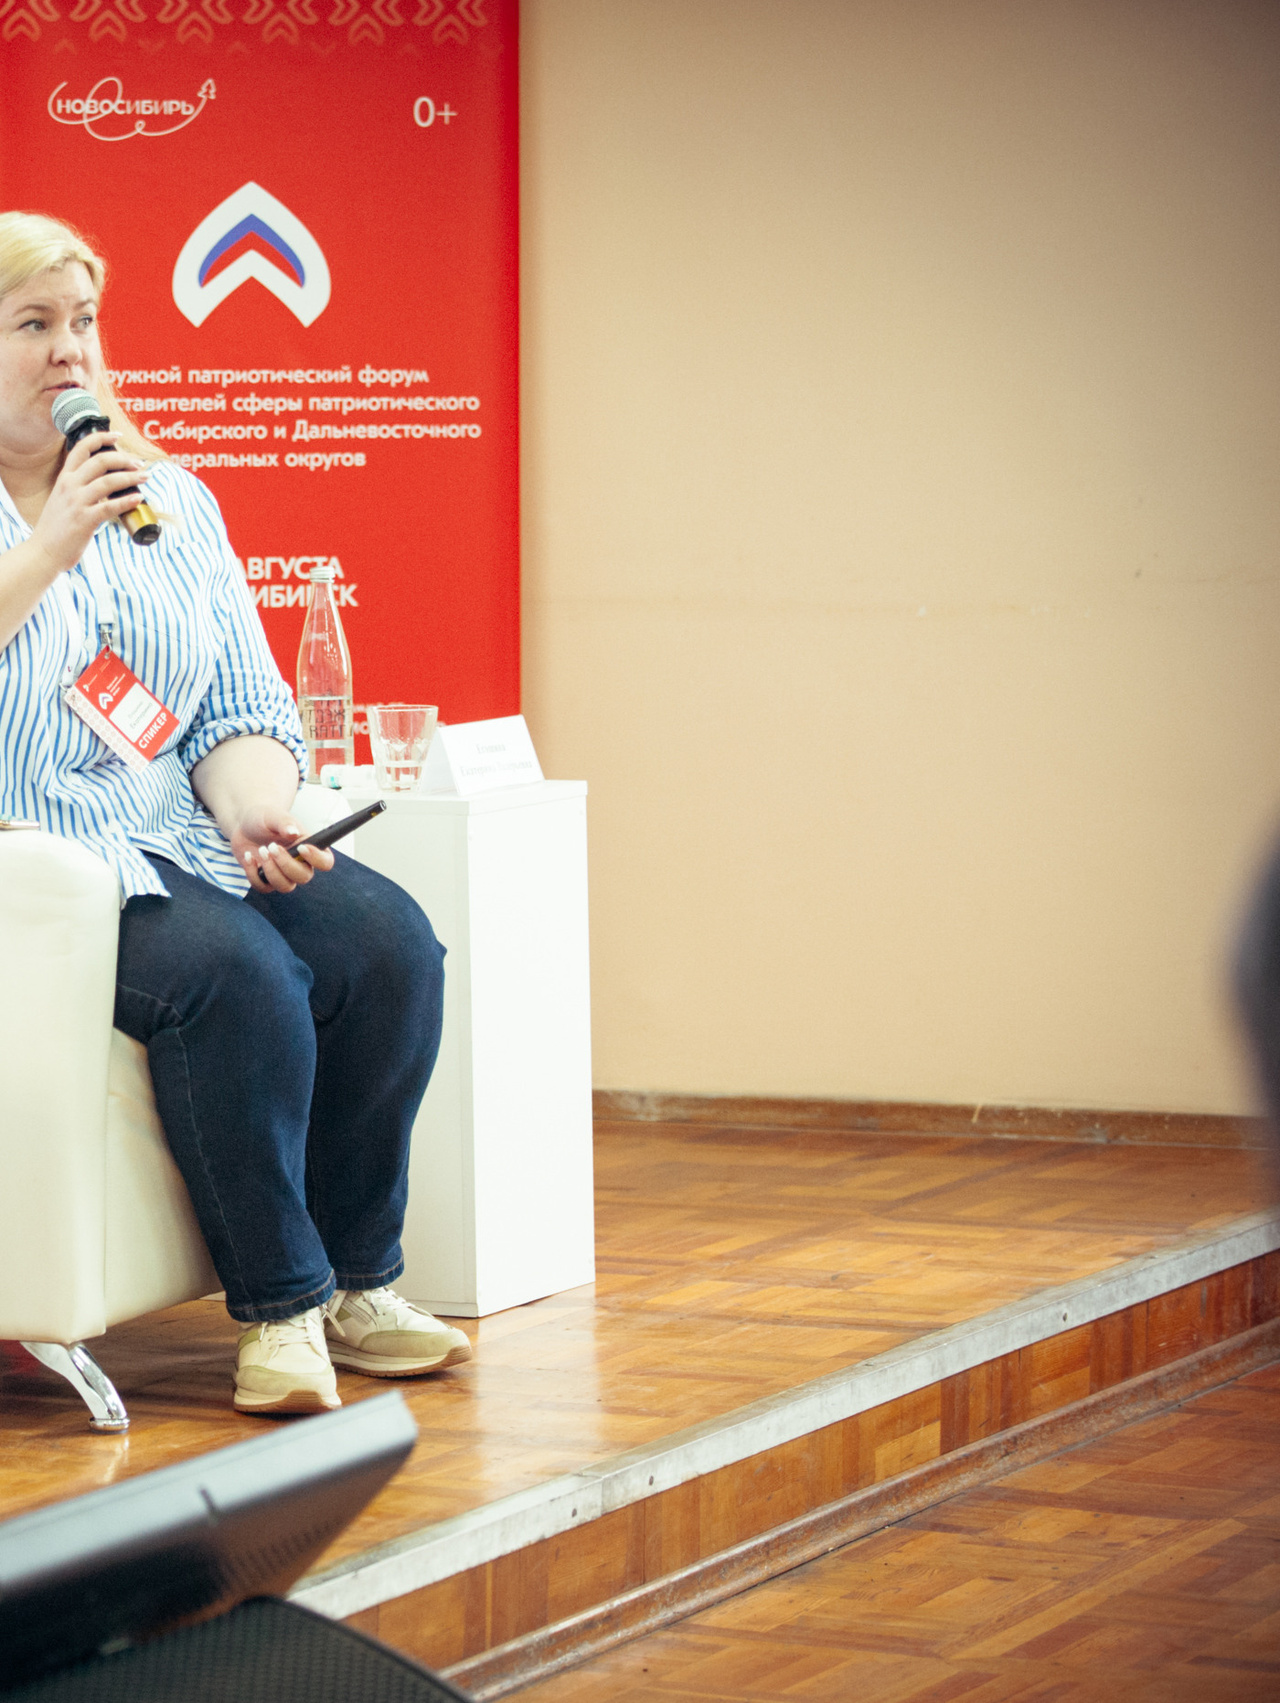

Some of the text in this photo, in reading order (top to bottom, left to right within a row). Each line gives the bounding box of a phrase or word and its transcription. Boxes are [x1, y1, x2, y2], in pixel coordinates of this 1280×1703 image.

[56, 98, 196, 116] НОВОСИБИРЬ
[413, 96, 458, 128] 0+
[106, 364, 429, 389] ружной патриотический форум
[120, 393, 481, 415] тавителей сферы патриотического
[143, 419, 482, 444] Сибирского и Дальневосточного
[168, 452, 367, 473] деральных округов
[138, 711, 168, 750] СПИКЕР
